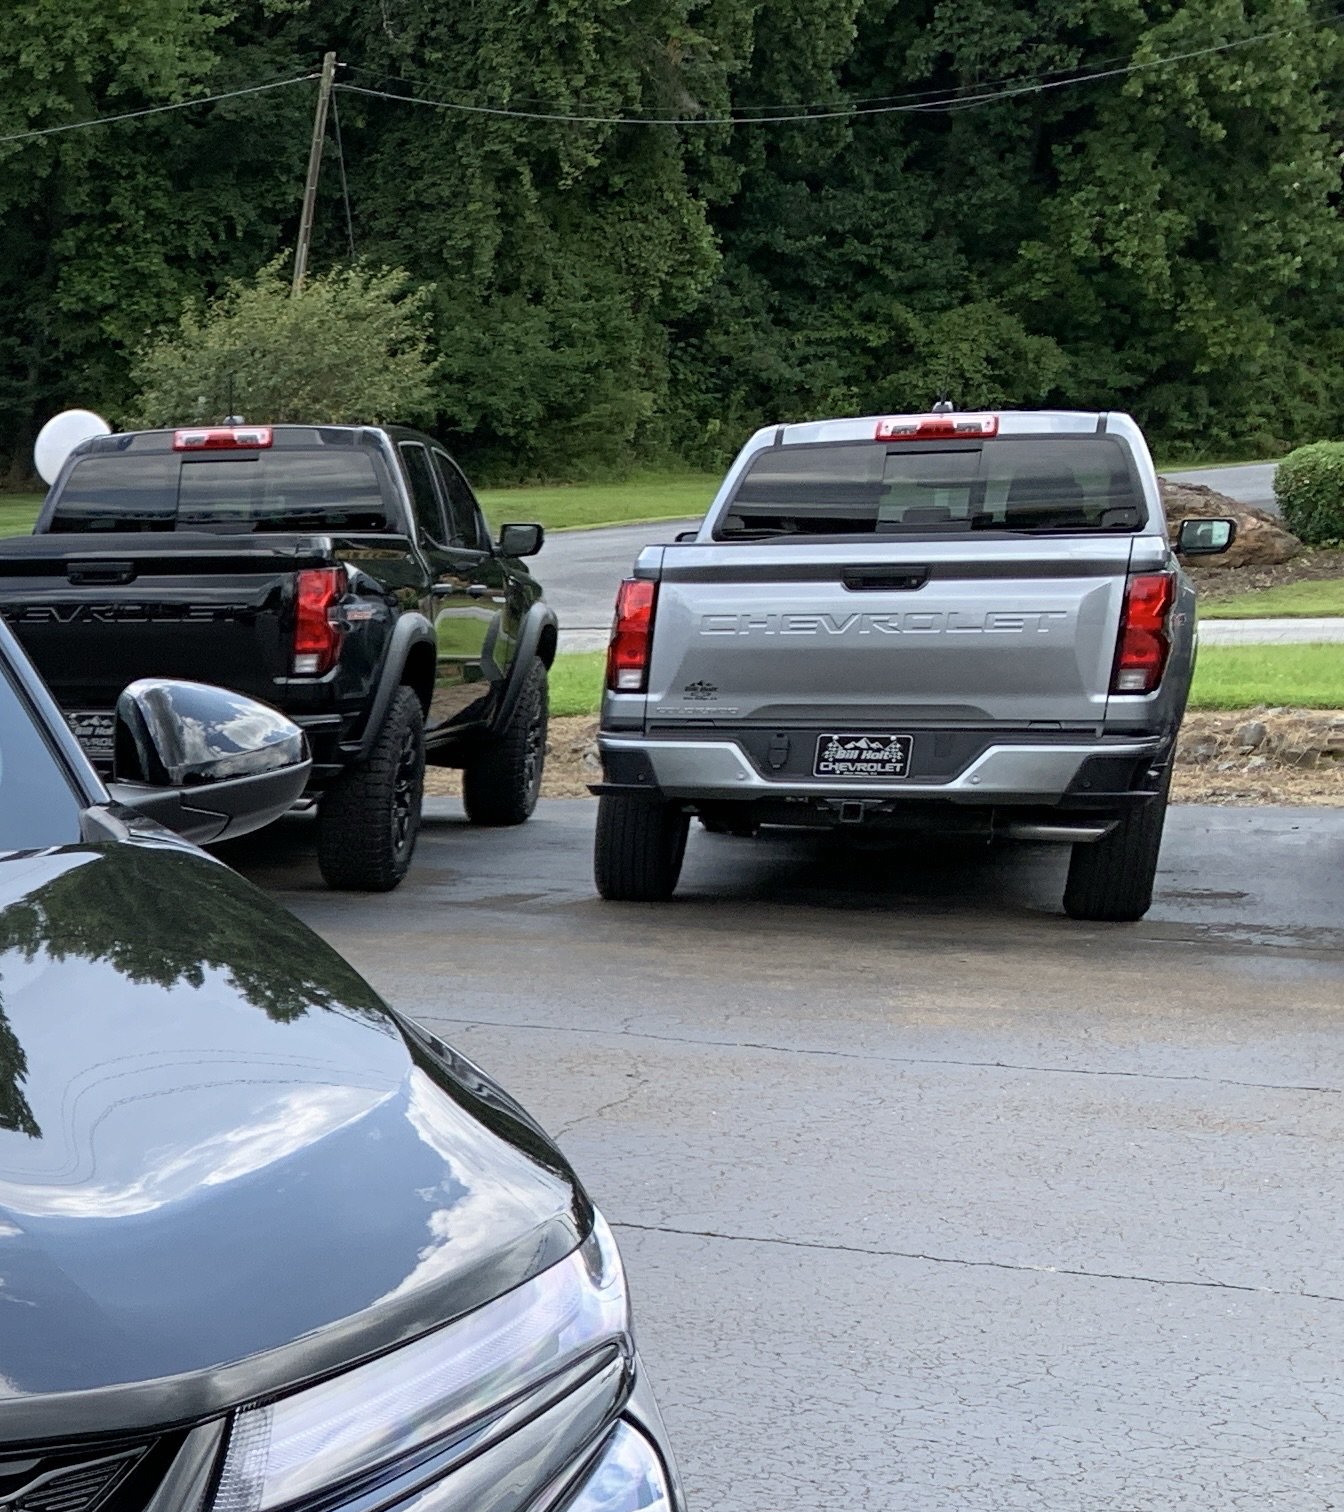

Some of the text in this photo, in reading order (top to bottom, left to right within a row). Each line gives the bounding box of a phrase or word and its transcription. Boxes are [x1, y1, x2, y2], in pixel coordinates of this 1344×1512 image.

[0, 604, 249, 624] EVROLET
[699, 610, 1067, 636] CHEVROLET
[835, 749, 890, 760] Bill Holt
[819, 761, 904, 772] CHEVROLET
